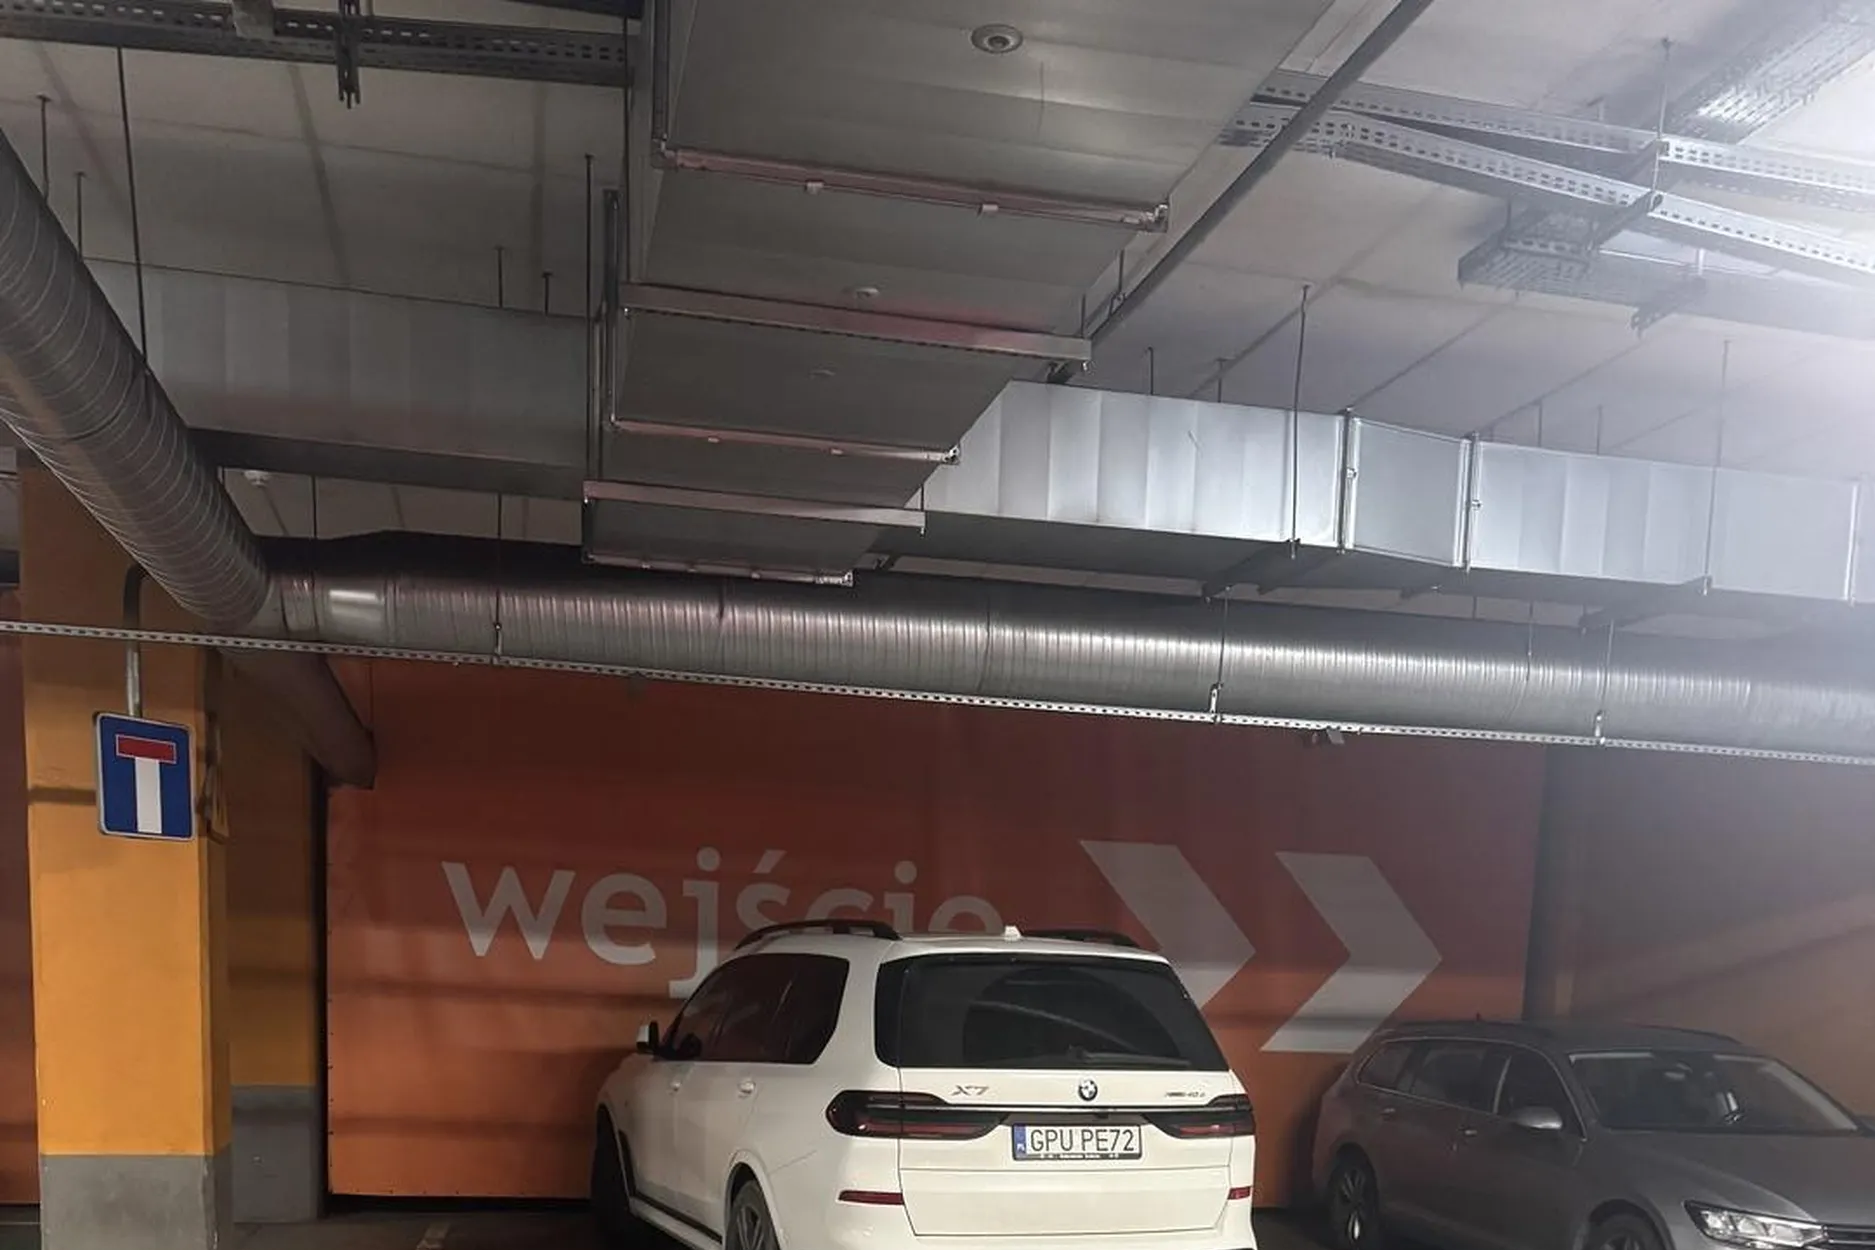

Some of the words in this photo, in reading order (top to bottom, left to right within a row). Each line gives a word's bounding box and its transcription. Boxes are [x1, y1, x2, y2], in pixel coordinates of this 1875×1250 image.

[951, 1085, 989, 1096] X7
[1030, 1129, 1073, 1151] GPU
[1081, 1129, 1135, 1151] PE72
